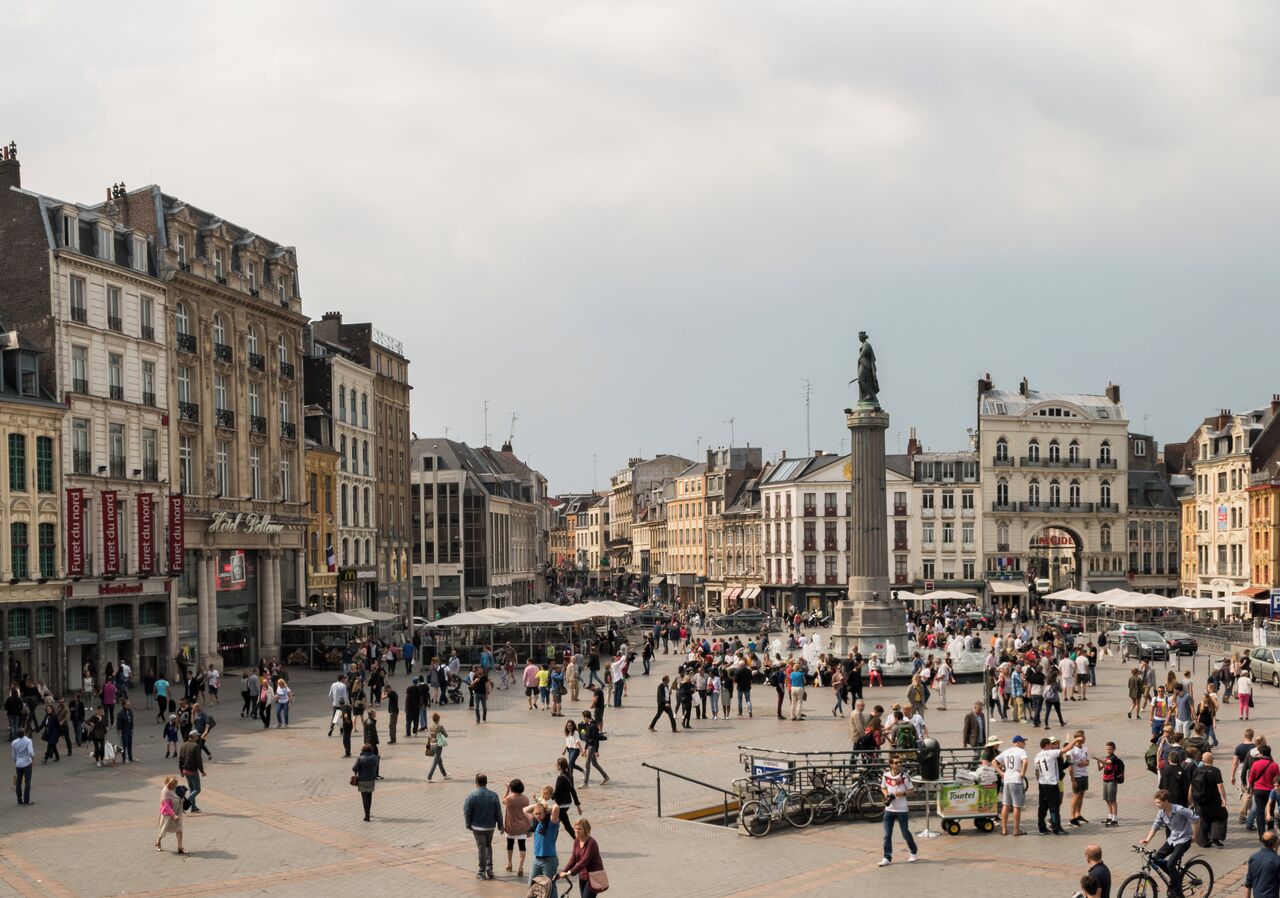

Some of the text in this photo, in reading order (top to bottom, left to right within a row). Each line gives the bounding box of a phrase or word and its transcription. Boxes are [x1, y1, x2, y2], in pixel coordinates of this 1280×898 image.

[71, 492, 81, 572] Furet du nord
[105, 494, 116, 571] Furet du nord
[141, 496, 151, 570] Furet du nord
[172, 498, 182, 570] Furet du nord
[1039, 536, 1073, 546] ALCIDE
[1007, 755, 1015, 770] 19
[1037, 758, 1049, 773] 11
[949, 791, 975, 800] Tourtel
